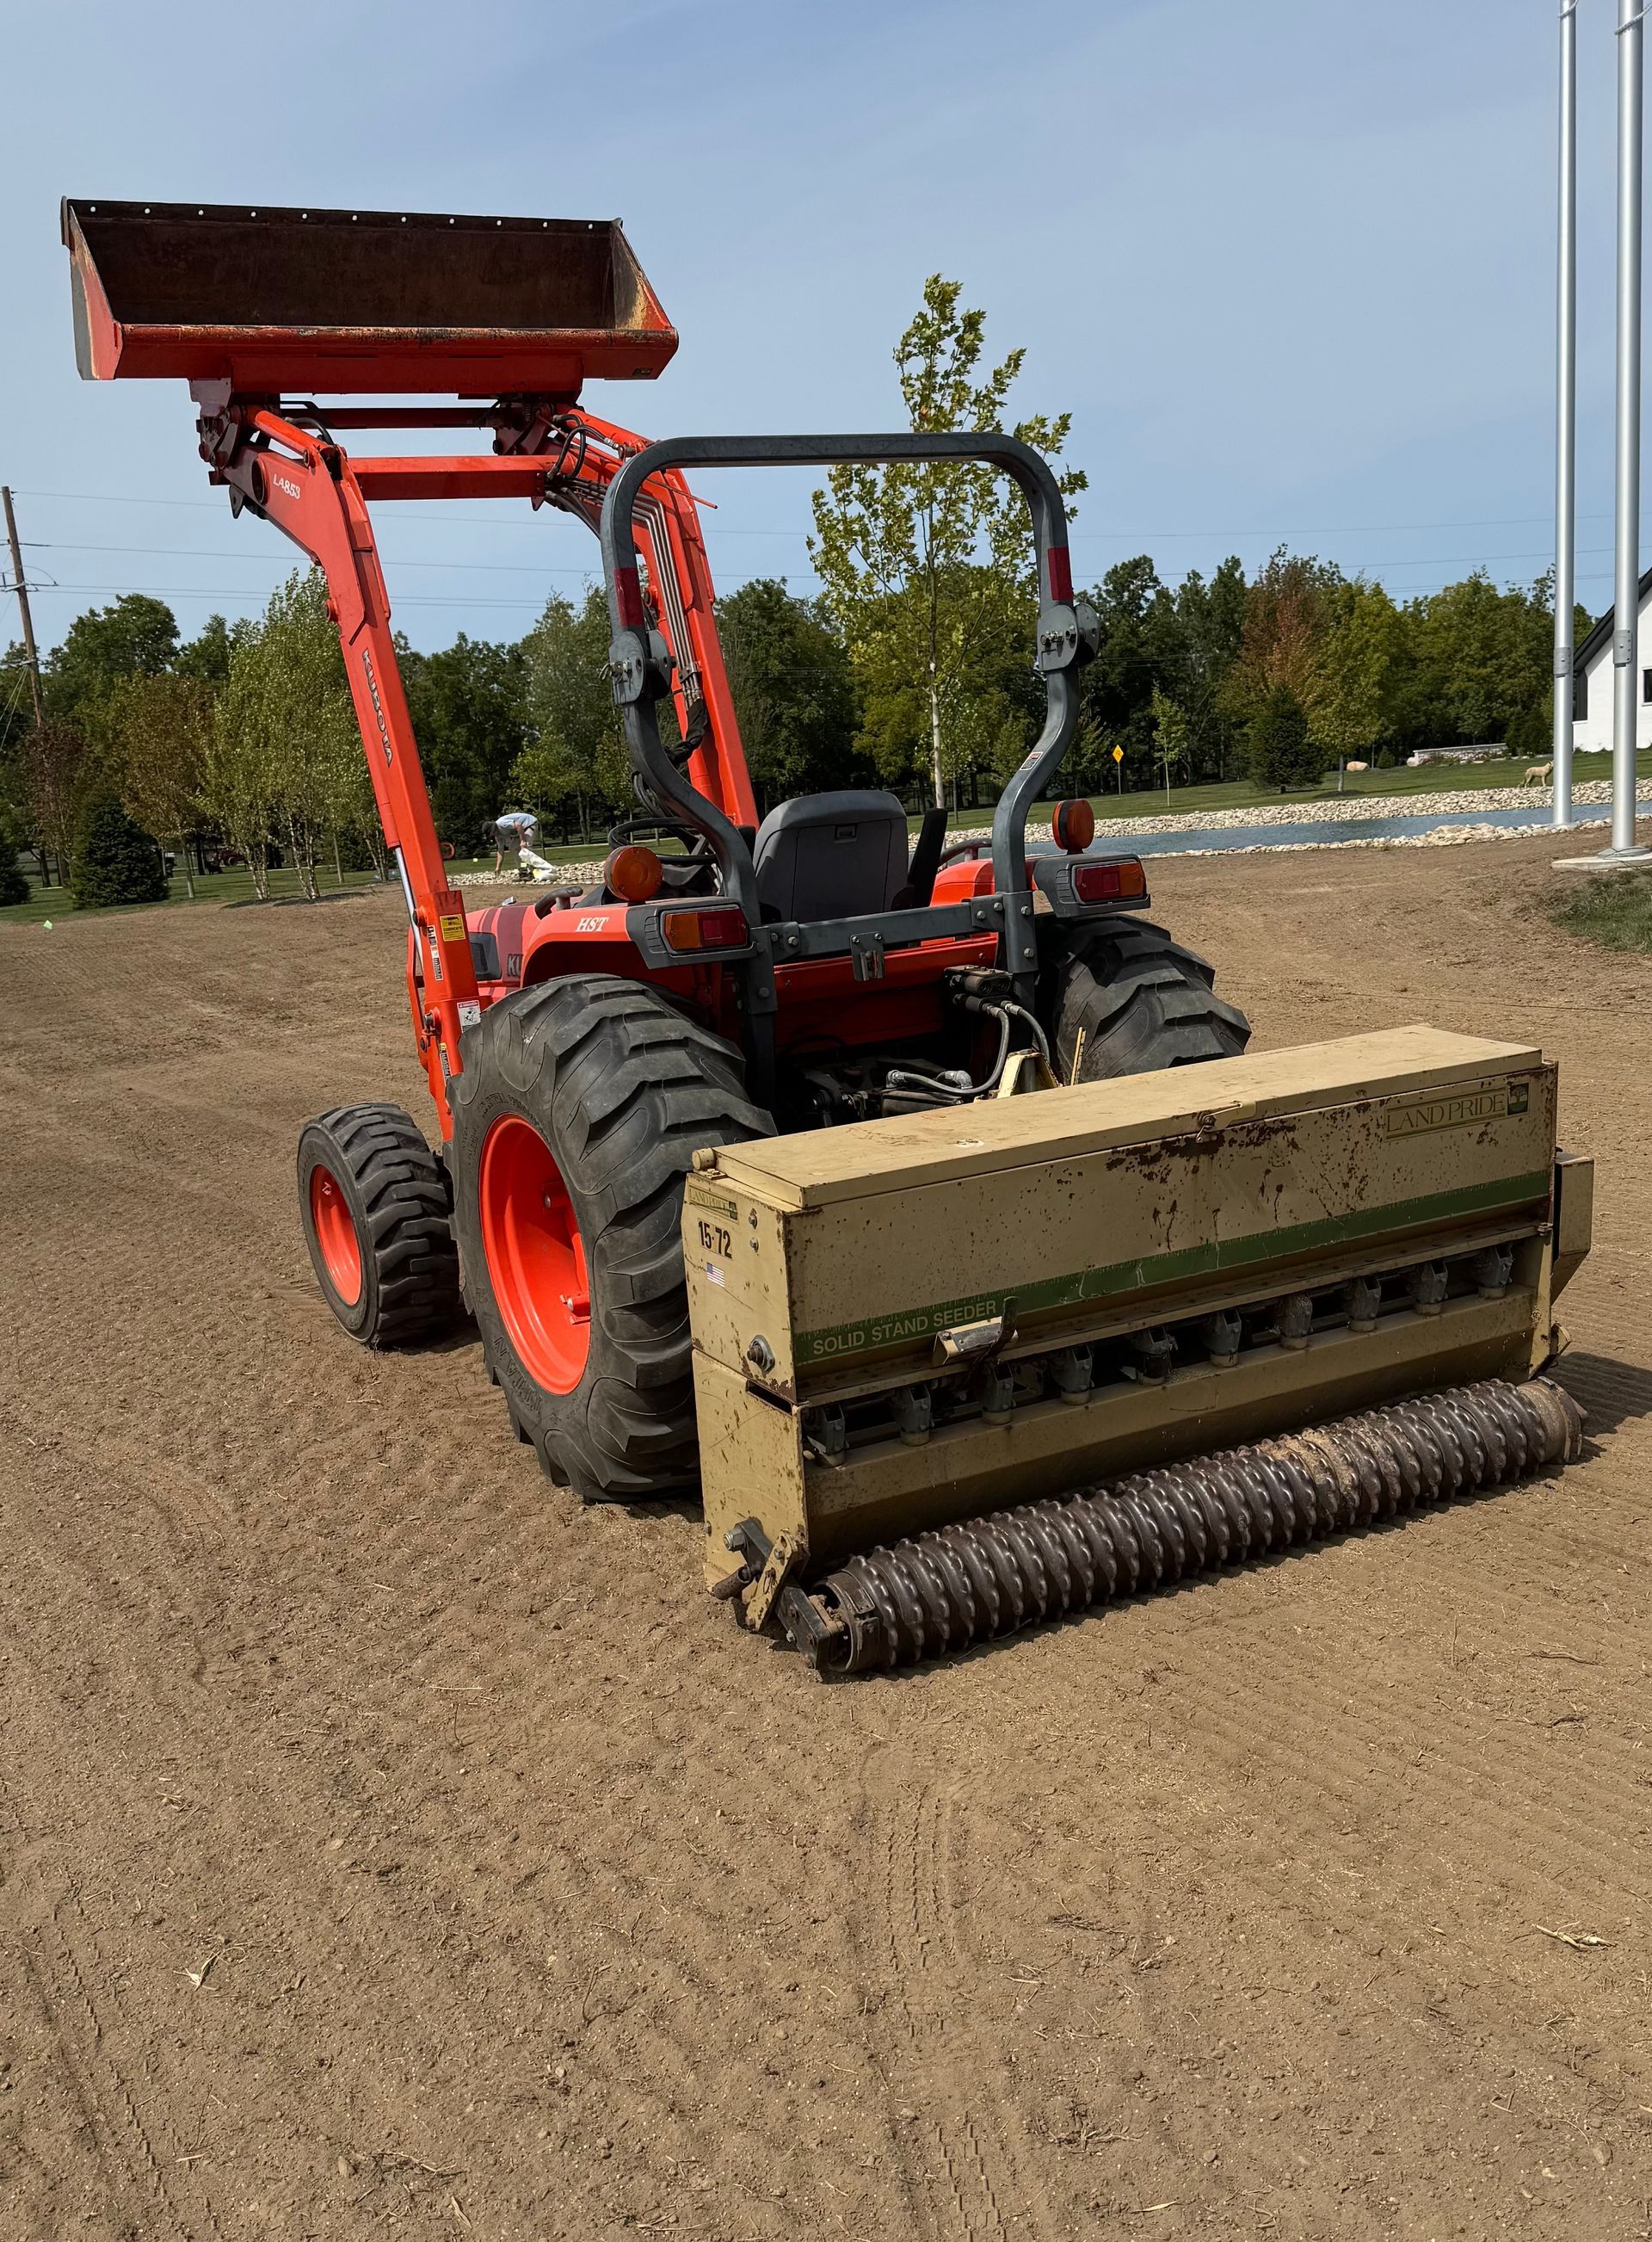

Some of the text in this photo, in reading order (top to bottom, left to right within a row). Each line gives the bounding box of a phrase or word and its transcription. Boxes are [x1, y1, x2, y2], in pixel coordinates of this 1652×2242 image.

[273, 473, 301, 500] LA853
[361, 647, 392, 769] KUBOTA
[575, 917, 609, 932] HST
[1386, 1093, 1506, 1133] LAND PRIDE
[812, 1300, 996, 1356] SOLID STAND SEEDER
